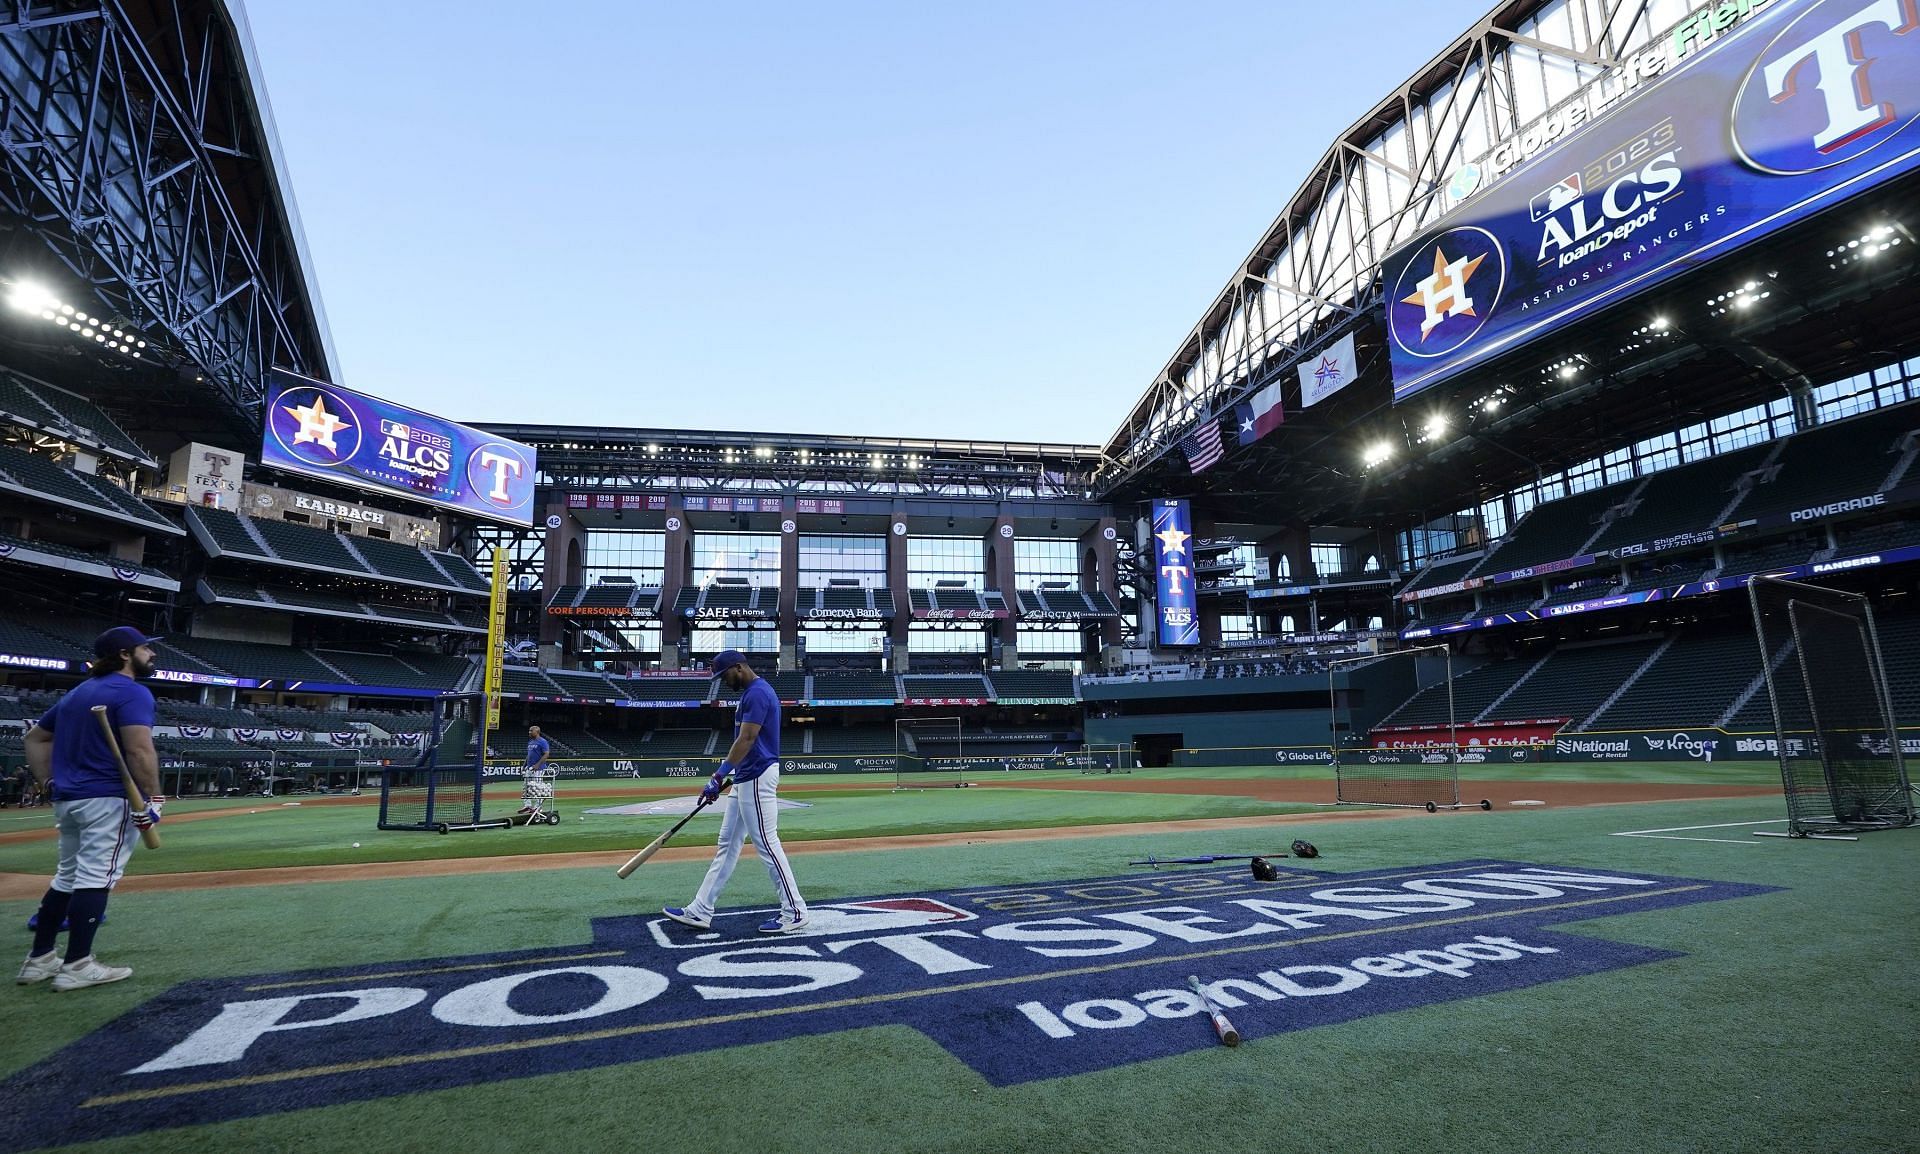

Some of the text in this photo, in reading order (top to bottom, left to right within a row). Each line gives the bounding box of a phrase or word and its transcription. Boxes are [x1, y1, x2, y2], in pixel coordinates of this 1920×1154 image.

[1492, 0, 1768, 173] Globe Life Fiel
[1584, 123, 1676, 188] 2023
[1536, 151, 1683, 262] ALCS
[1558, 205, 1658, 269] loanDepot
[1520, 271, 1590, 311] ASTROS
[1623, 205, 1726, 262] RANGERS
[410, 430, 451, 448] 2023
[379, 436, 450, 472] ALCS
[204, 452, 231, 477] T
[388, 459, 438, 478] loanDepot
[365, 469, 404, 483] ASTROS
[418, 482, 461, 497] RANGERS
[481, 451, 523, 504] T
[295, 496, 385, 525] KARBACH
[1790, 493, 1888, 522] POWERADE
[548, 517, 560, 526] 42
[668, 520, 679, 528] 34
[783, 522, 794, 530] 26
[897, 525, 903, 533] 7
[1002, 527, 1011, 535] 29
[1105, 529, 1114, 537] 10
[1653, 530, 1714, 546] ShipPGL.com
[1654, 534, 1714, 551] 877.701.1919
[1621, 542, 1649, 556] PGL
[1813, 555, 1881, 573] RANGERS
[1161, 565, 1188, 595] T
[1510, 568, 1534, 579] 105.3
[1417, 582, 1465, 599] WHATABURGER
[548, 607, 574, 615] CORE
[576, 606, 631, 615] PERSONNEL
[698, 607, 730, 618] SAFE
[856, 608, 882, 617] Bank
[927, 608, 955, 619] Coca-Cola
[968, 609, 996, 619] Coca-Cola
[1029, 609, 1080, 618] CHOCTAW
[1562, 603, 1585, 613] ALCS
[1164, 613, 1192, 623] ALCS
[1294, 635, 1315, 643] HART
[1404, 629, 1431, 638] ASTROS
[491, 647, 503, 688] HEAT
[166, 670, 193, 682] ALCS
[1572, 739, 1630, 752] National
[1766, 738, 1807, 751] BTE
[856, 758, 896, 766] CHOCTAW
[1288, 751, 1332, 761] Globe Life
[613, 760, 634, 771] UTA
[797, 761, 838, 771] Medical City
[126, 867, 1661, 1076] POSTSEASON
[1015, 934, 1562, 1041] loanDepot
